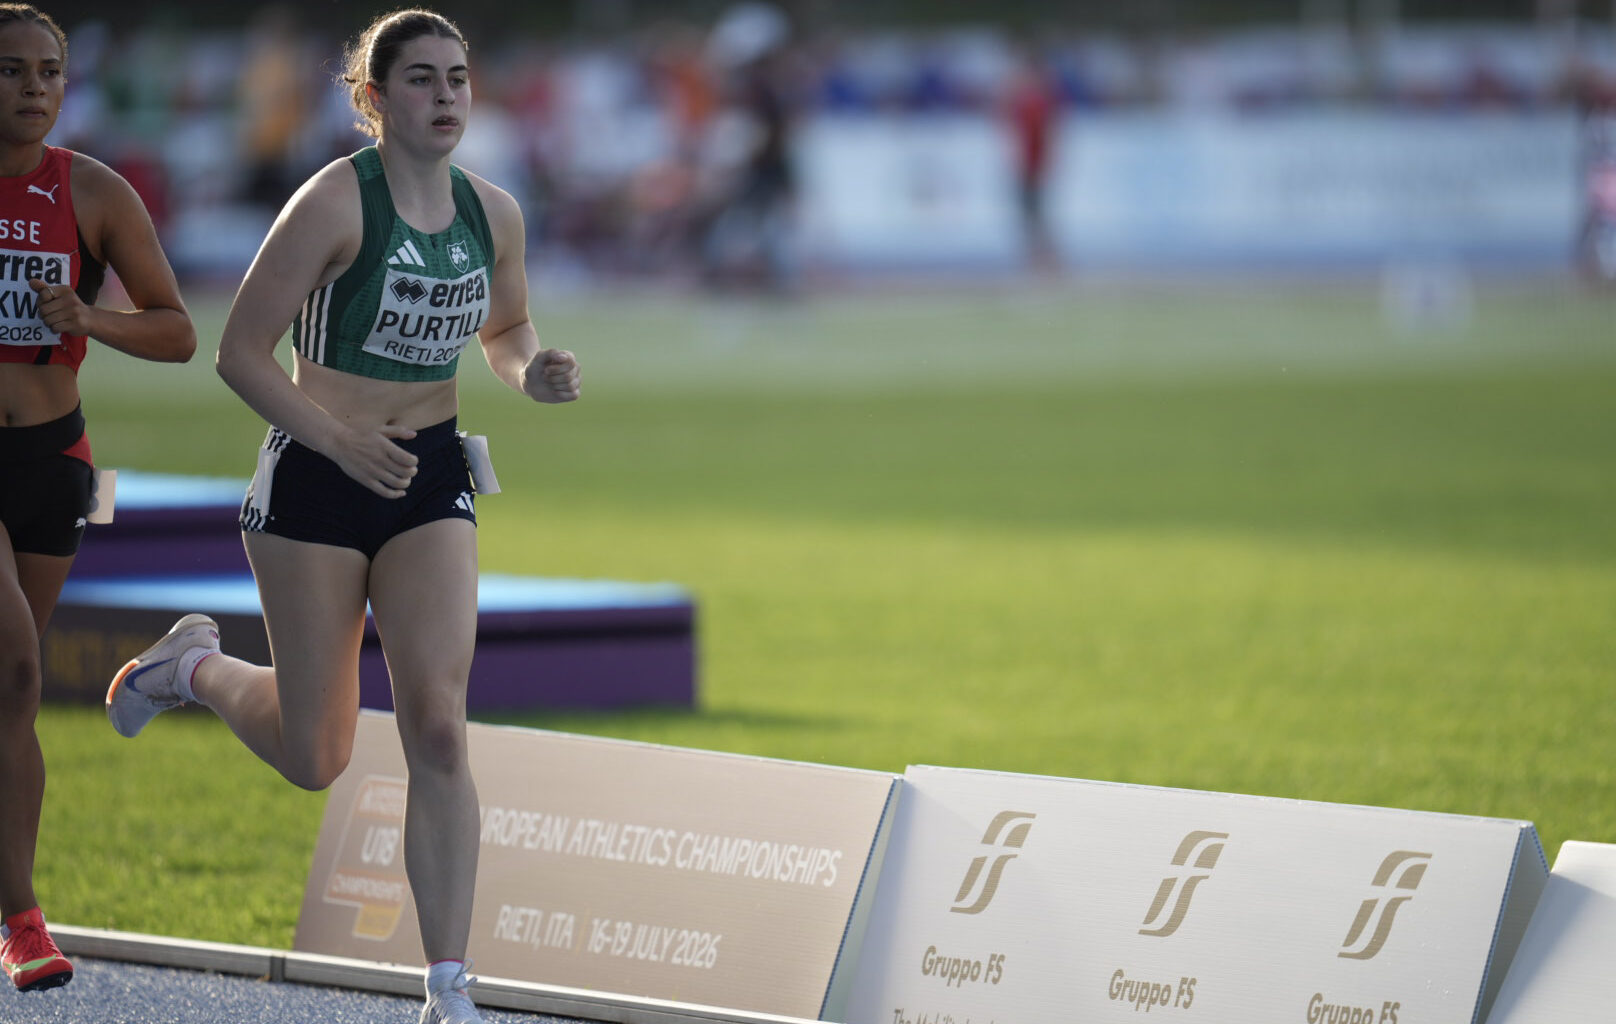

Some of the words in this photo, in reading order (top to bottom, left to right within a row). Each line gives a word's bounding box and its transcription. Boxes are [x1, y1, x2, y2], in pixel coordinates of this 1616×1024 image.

[0, 325, 43, 341] 2026
[375, 309, 482, 341] PURTILL
[384, 340, 432, 362] RIETI
[565, 818, 676, 867] ATHLETICS
[675, 831, 842, 887] CHAMPIONSHIPS
[493, 904, 544, 948] RIETI,
[544, 911, 576, 949] ITA
[587, 917, 632, 956] 16-19
[626, 924, 677, 962] JULY
[671, 928, 722, 969] 2026
[921, 945, 982, 988] Gruppo
[984, 953, 1006, 985] FS
[1108, 969, 1172, 1013] Gruppo
[1174, 977, 1197, 1010] FS
[1307, 992, 1375, 1024] Gruppo
[1379, 1001, 1401, 1024] FS
